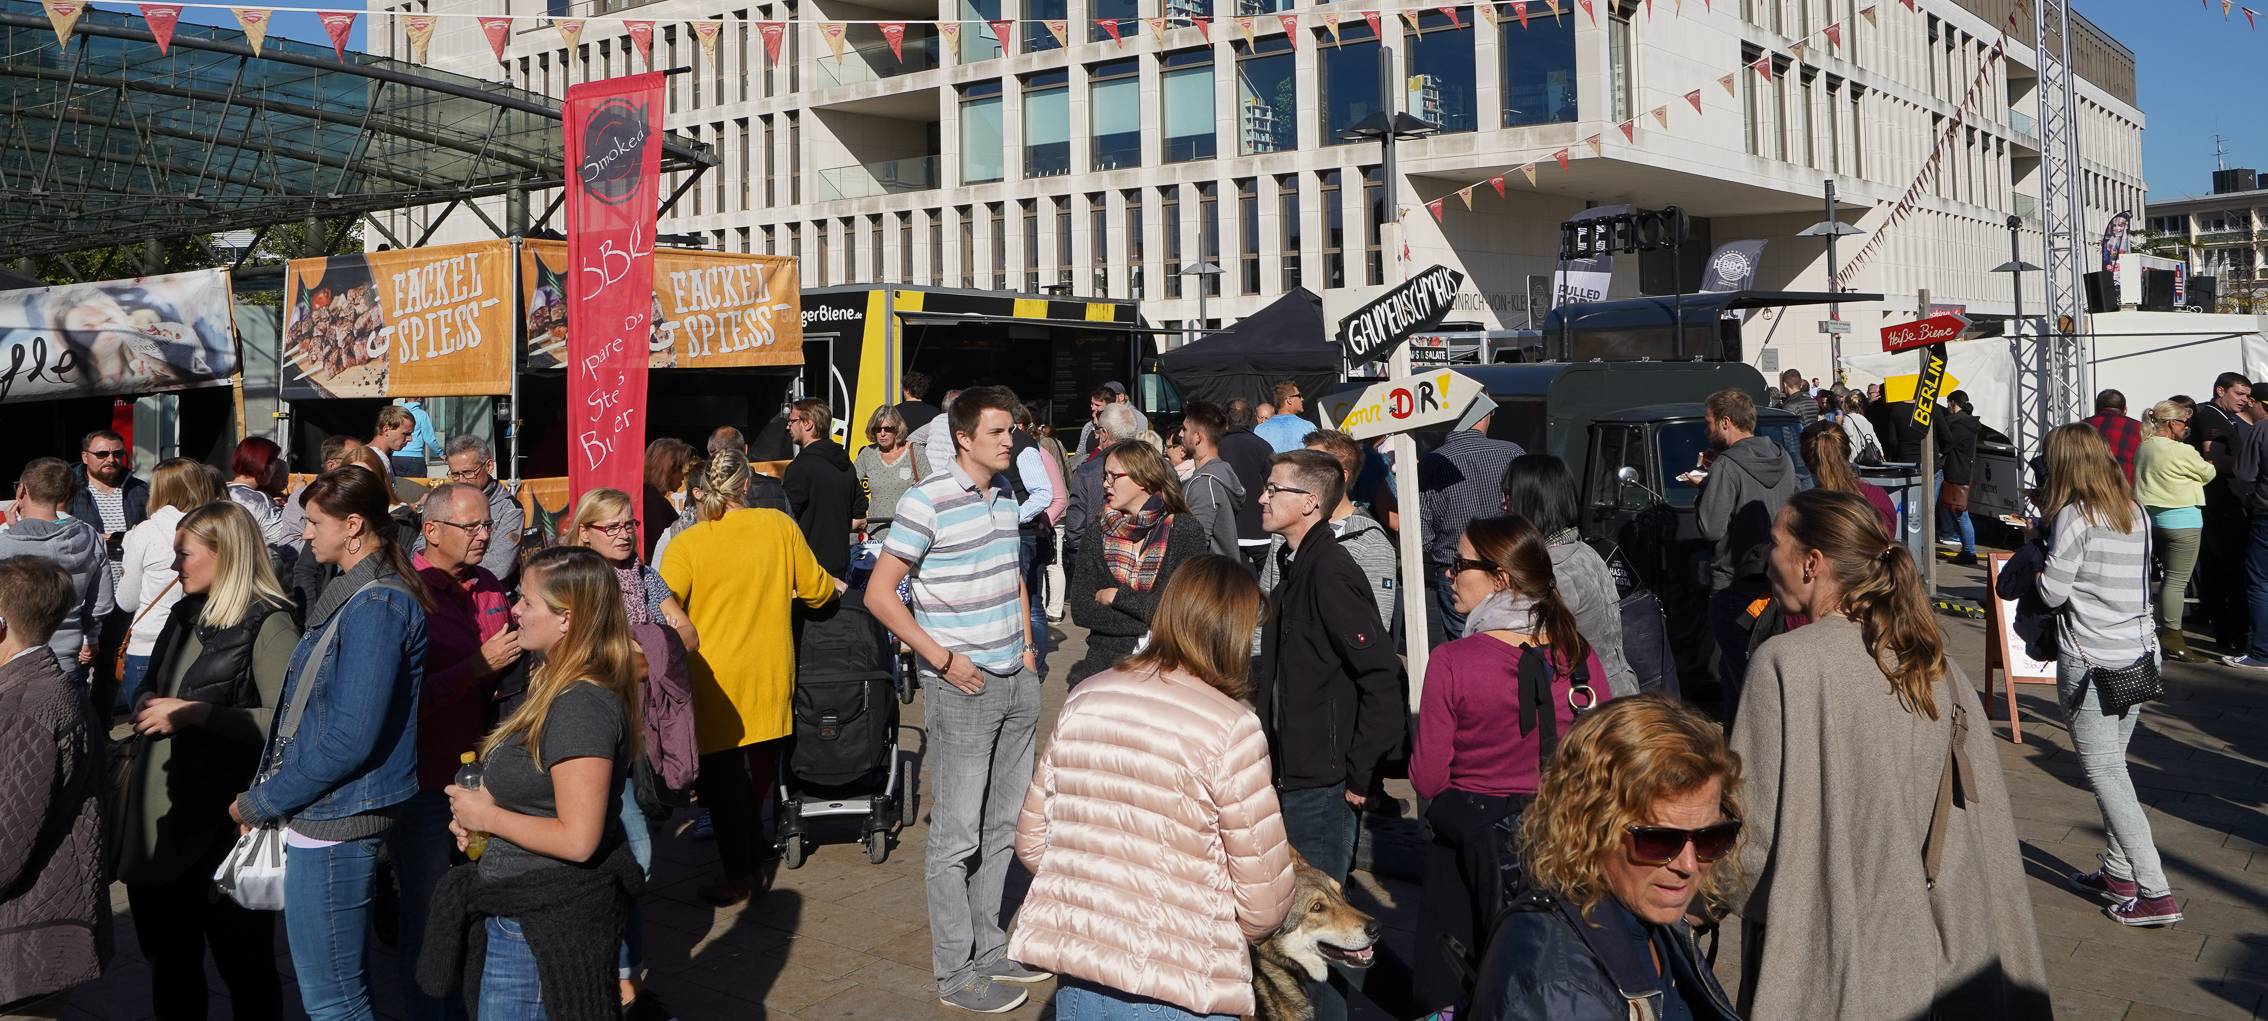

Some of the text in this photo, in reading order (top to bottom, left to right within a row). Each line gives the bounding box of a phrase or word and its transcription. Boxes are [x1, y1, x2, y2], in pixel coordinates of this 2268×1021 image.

[585, 119, 646, 183] Smoked
[392, 253, 483, 318] FACKEL
[670, 263, 771, 314] FACKEL
[1348, 267, 1458, 355] GAUMENSCHMAUS
[397, 300, 482, 364] SPIESS
[683, 306, 776, 358] SPIESS
[1425, 350, 1446, 360] SALATE
[1888, 323, 1954, 347] Heiße Biene
[1389, 371, 1451, 420] DIR!
[1914, 355, 1944, 426] BERLIN
